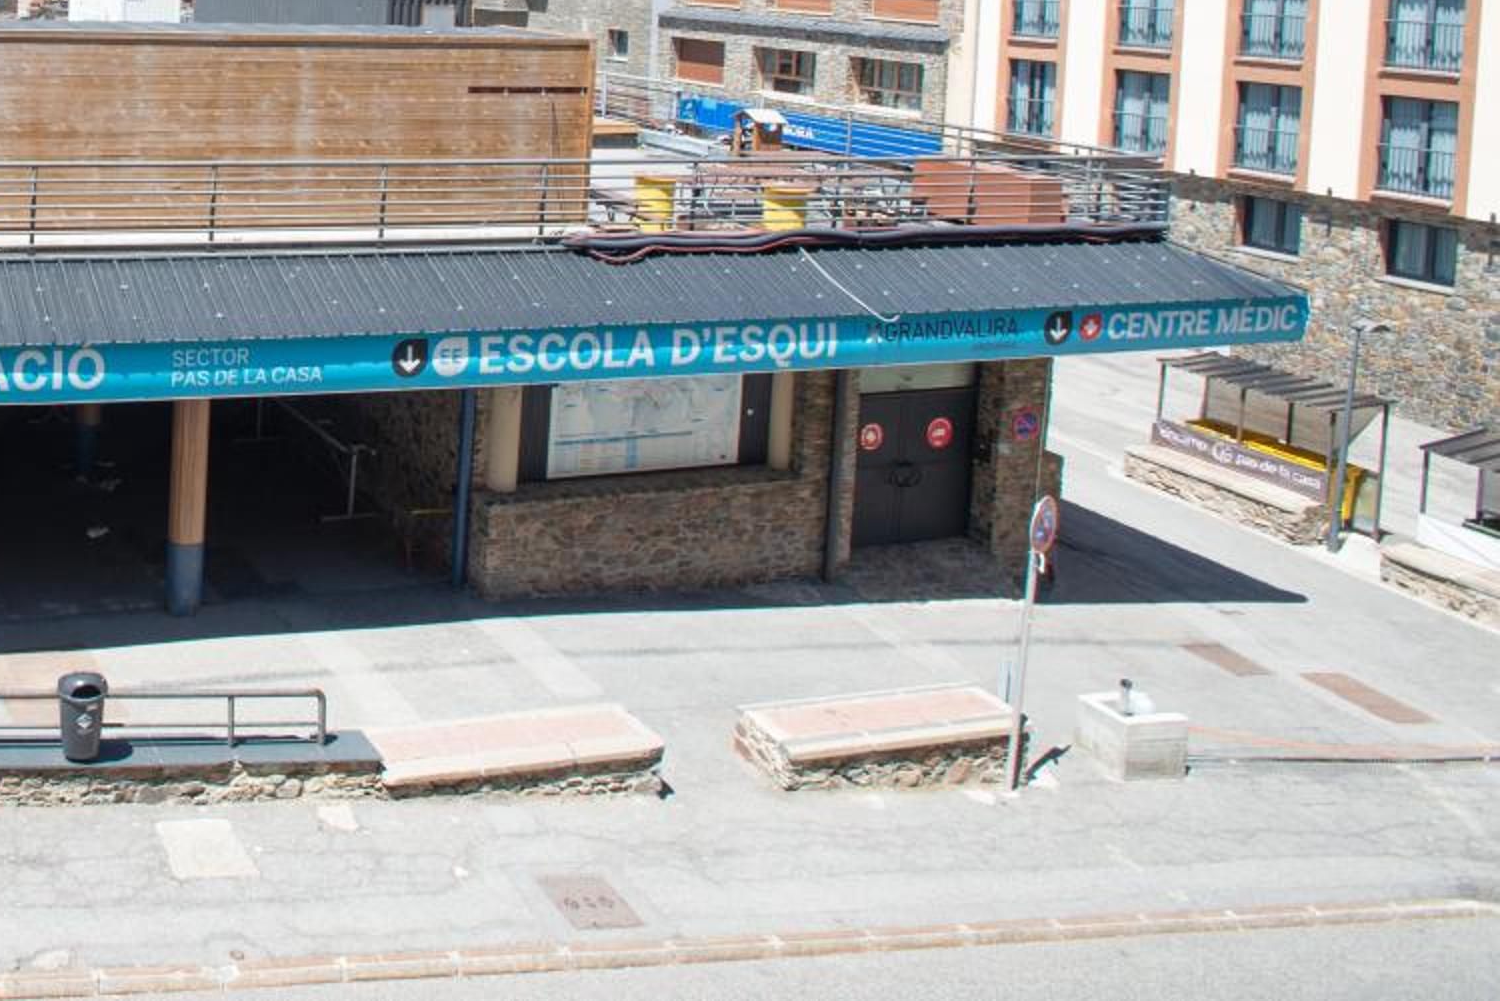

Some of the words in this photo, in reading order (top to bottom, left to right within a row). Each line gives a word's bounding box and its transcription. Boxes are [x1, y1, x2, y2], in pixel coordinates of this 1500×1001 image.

[885, 316, 1019, 341] GRANDVALIRA
[1107, 309, 1210, 340] CENTRE
[171, 348, 250, 368] SECTOR
[478, 331, 656, 375] ESCOLA
[171, 370, 209, 388] PAS
[213, 370, 238, 386] DE
[242, 369, 268, 385] LA
[271, 366, 323, 384] CASA
